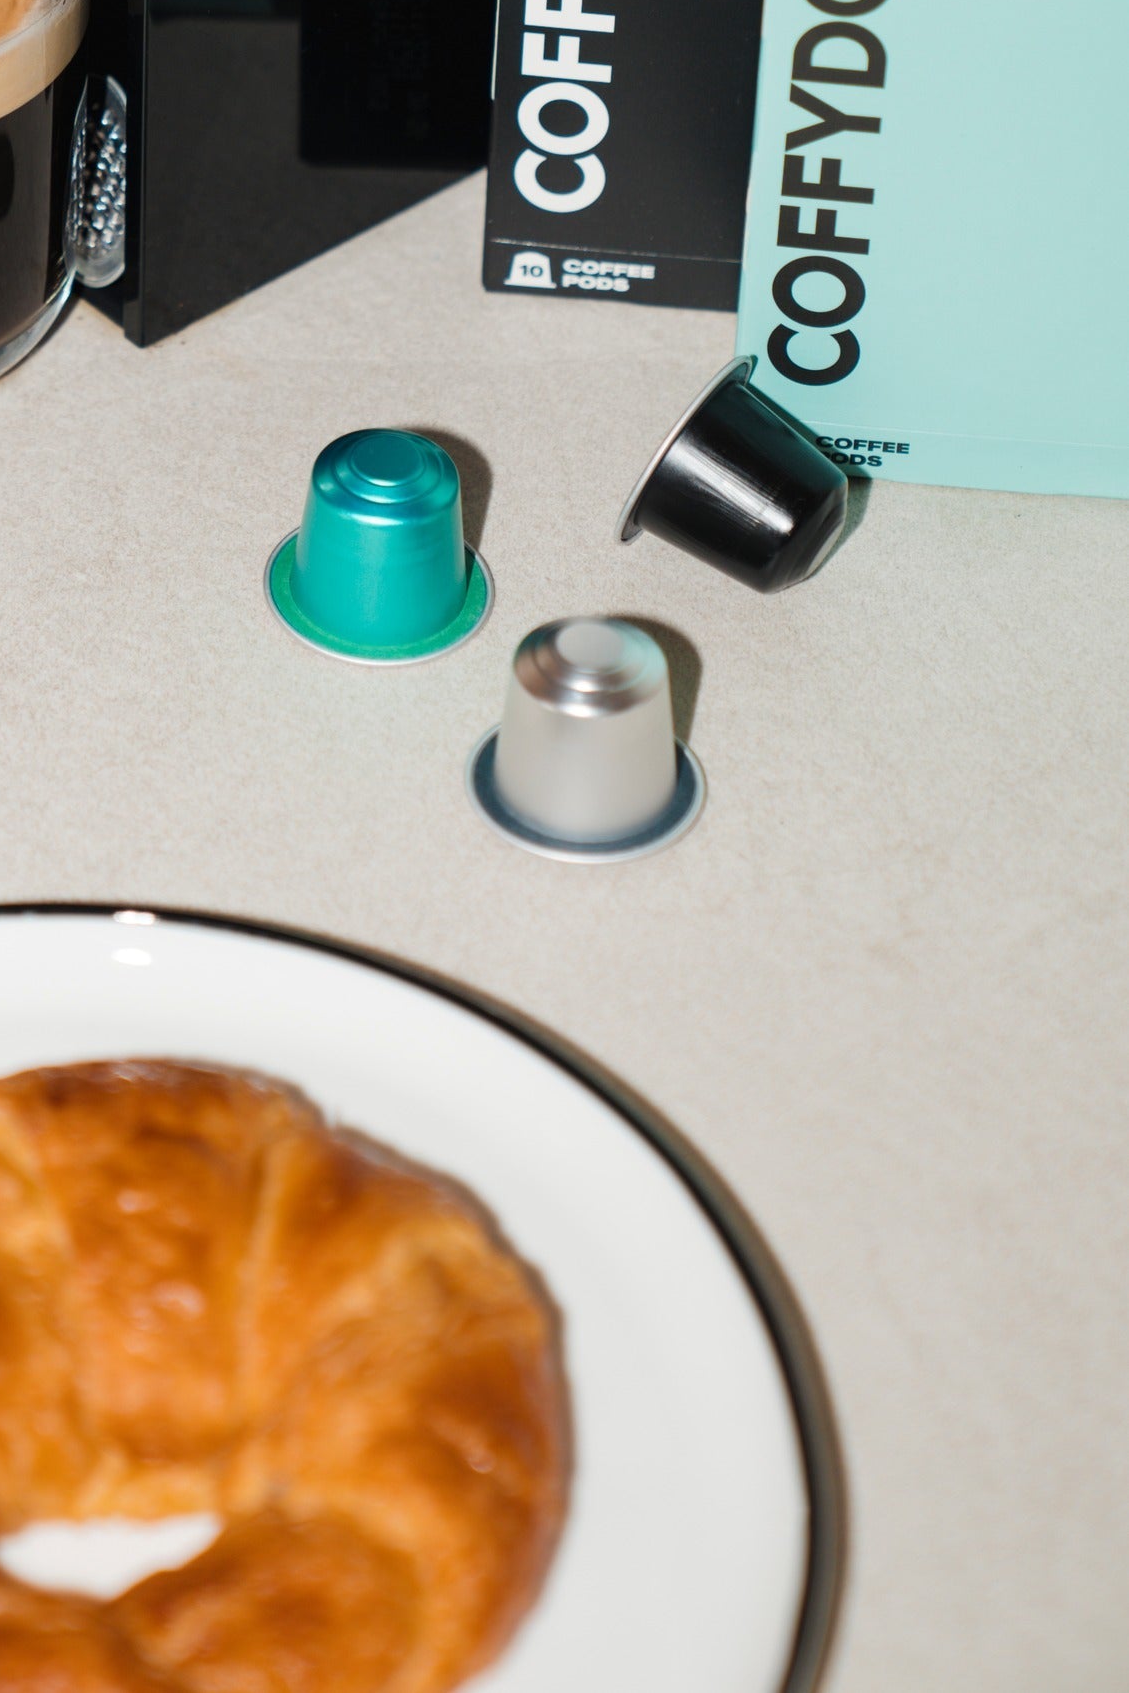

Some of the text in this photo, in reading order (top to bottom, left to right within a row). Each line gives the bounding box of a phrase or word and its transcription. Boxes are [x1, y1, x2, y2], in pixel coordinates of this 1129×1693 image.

[520, 264, 544, 278] 10
[562, 259, 655, 279] COFFEE
[562, 273, 630, 292] PODS
[816, 436, 910, 454] COFFEE
